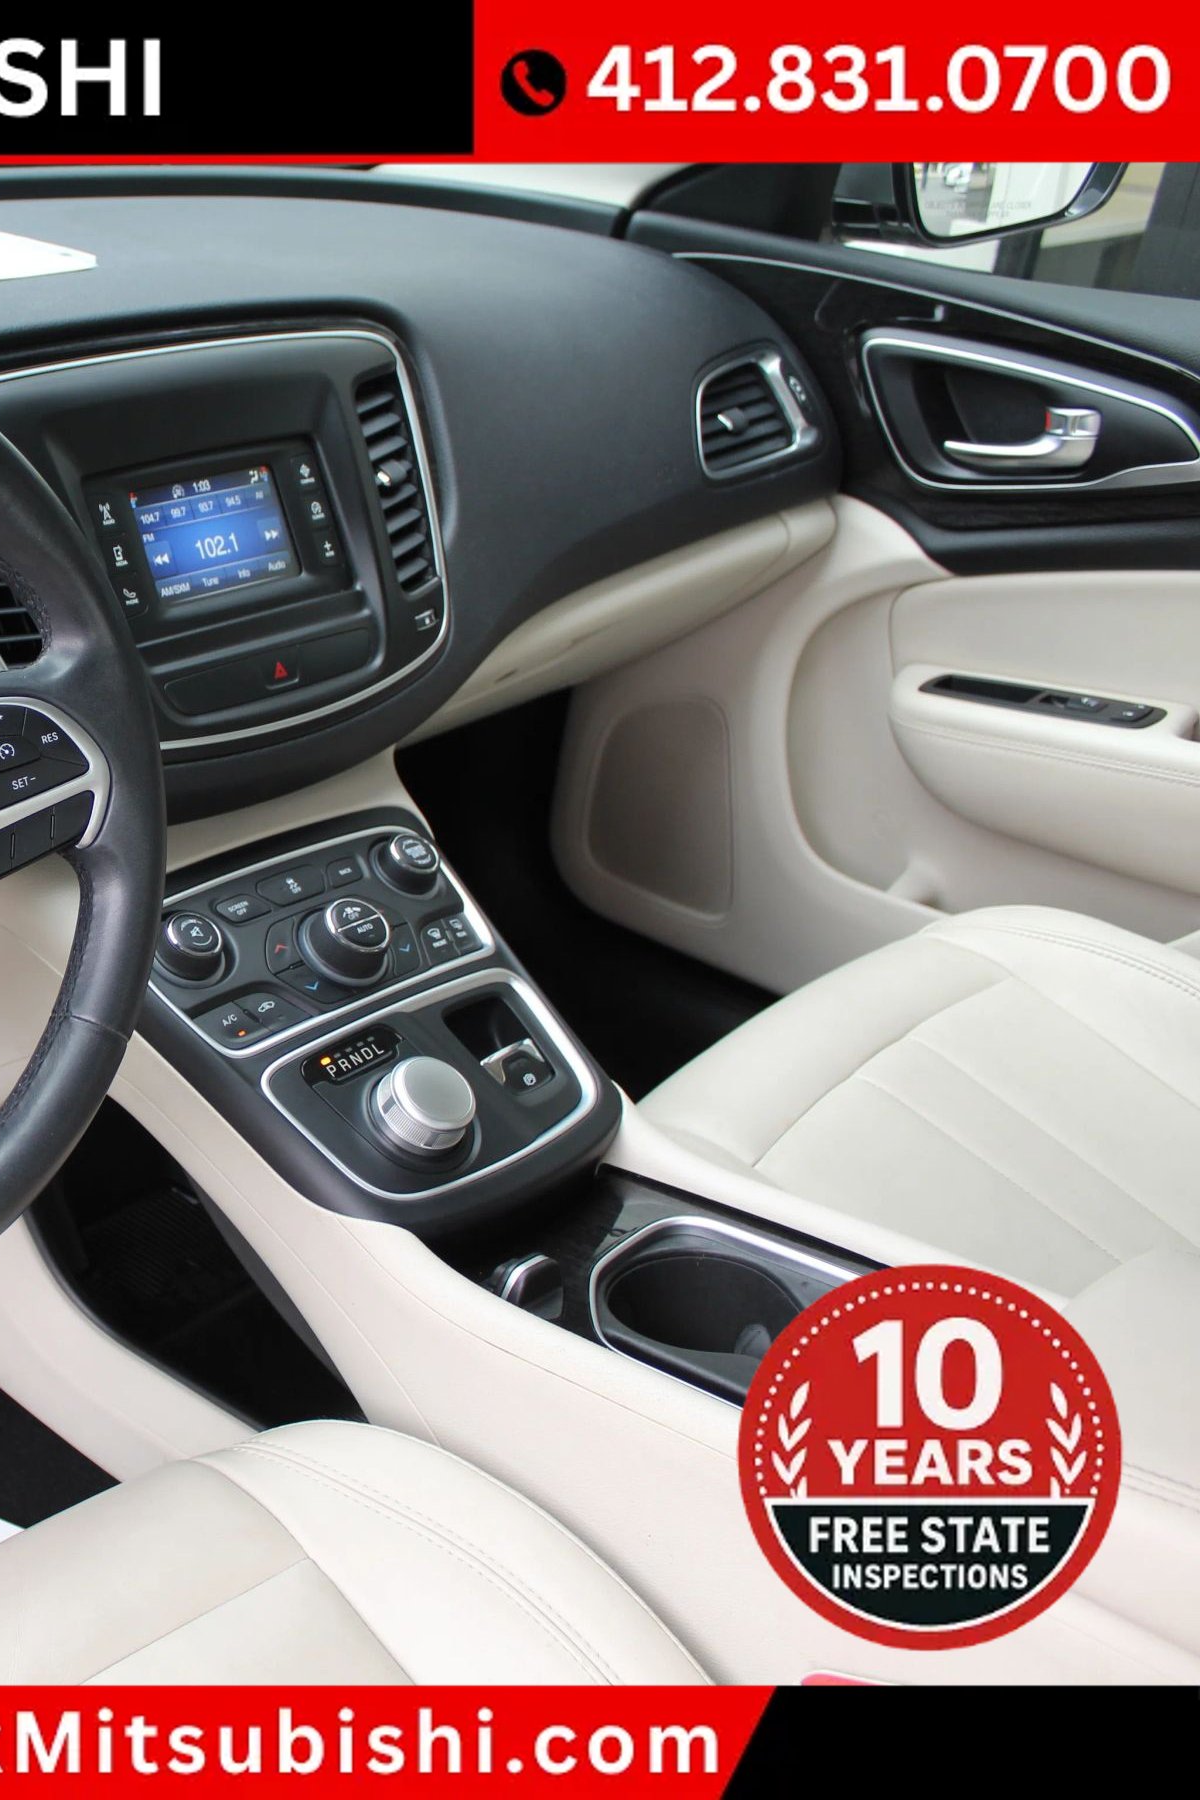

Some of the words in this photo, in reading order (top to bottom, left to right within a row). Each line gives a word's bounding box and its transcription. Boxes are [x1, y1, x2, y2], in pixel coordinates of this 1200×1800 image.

[192, 480, 211, 493] 1:03
[140, 512, 160, 525] 104.7
[142, 533, 155, 543] FM
[195, 532, 239, 560] 102.1
[268, 561, 286, 571] Audio
[41, 732, 59, 745] RES
[227, 900, 249, 913] SCREEN
[236, 907, 247, 916] OFF
[357, 923, 374, 934] AUTO
[222, 1014, 238, 1027] A/C
